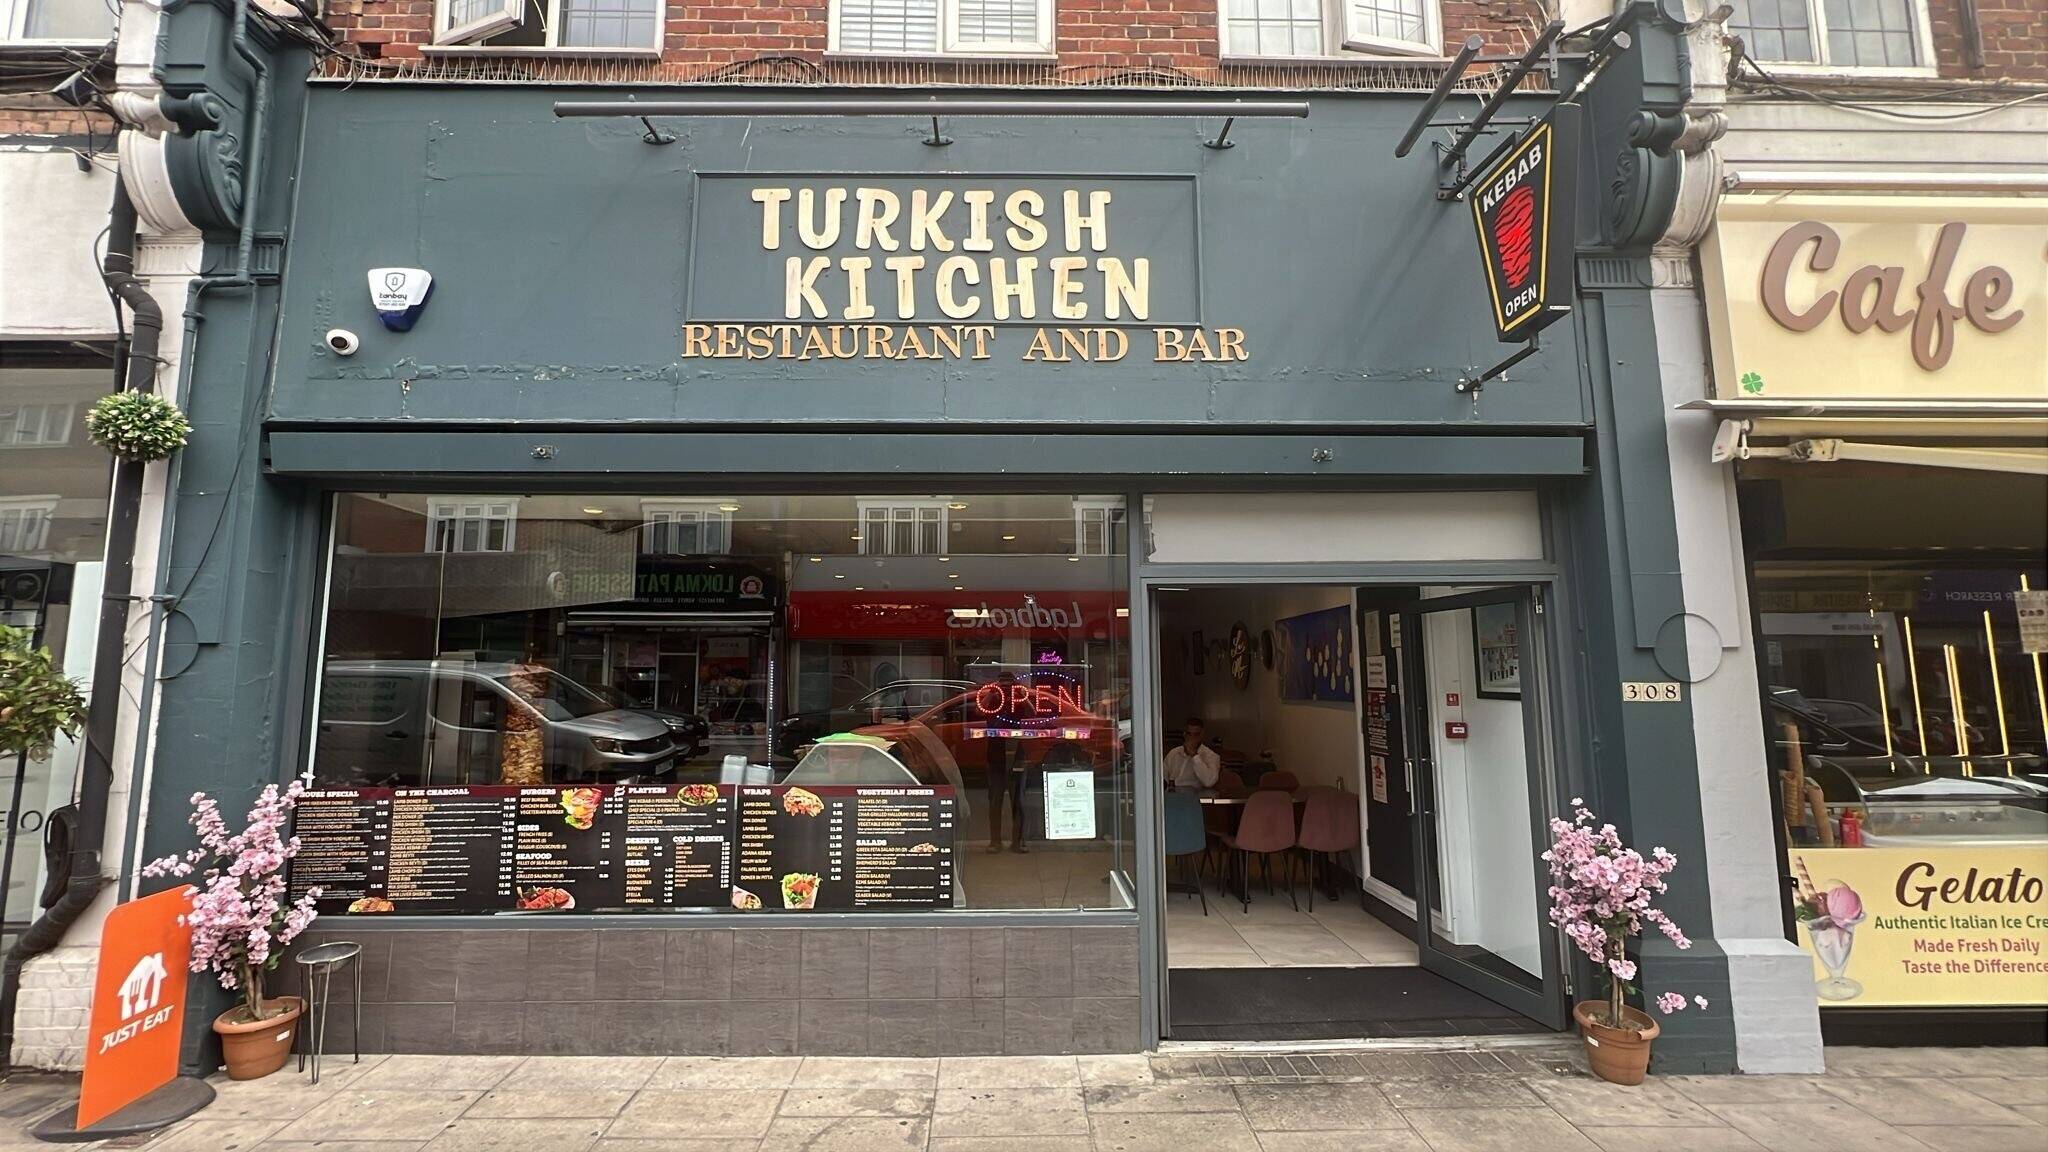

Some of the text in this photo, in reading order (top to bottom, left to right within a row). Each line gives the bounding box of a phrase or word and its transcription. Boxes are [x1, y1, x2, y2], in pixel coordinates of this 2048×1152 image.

[1483, 144, 1542, 212] KEBAB
[752, 188, 1111, 252] TURKISH
[785, 256, 1150, 321] KITCHEN
[1505, 284, 1537, 317] OPEN
[1761, 220, 2024, 372] Cafe
[681, 324, 1249, 363] RESTAURANT AND BAR
[976, 683, 1081, 714] OPEN
[1627, 685, 1676, 699] 308
[1895, 861, 2043, 911] Gelato
[1874, 915, 1947, 929] Authentic
[1950, 915, 1998, 929] Italian
[2001, 915, 2023, 929] Ice
[1902, 959, 2048, 974] Taste the Difference
[1914, 939, 2040, 955] Made Fresh Daily
[99, 1004, 174, 1055] JUST EAT
